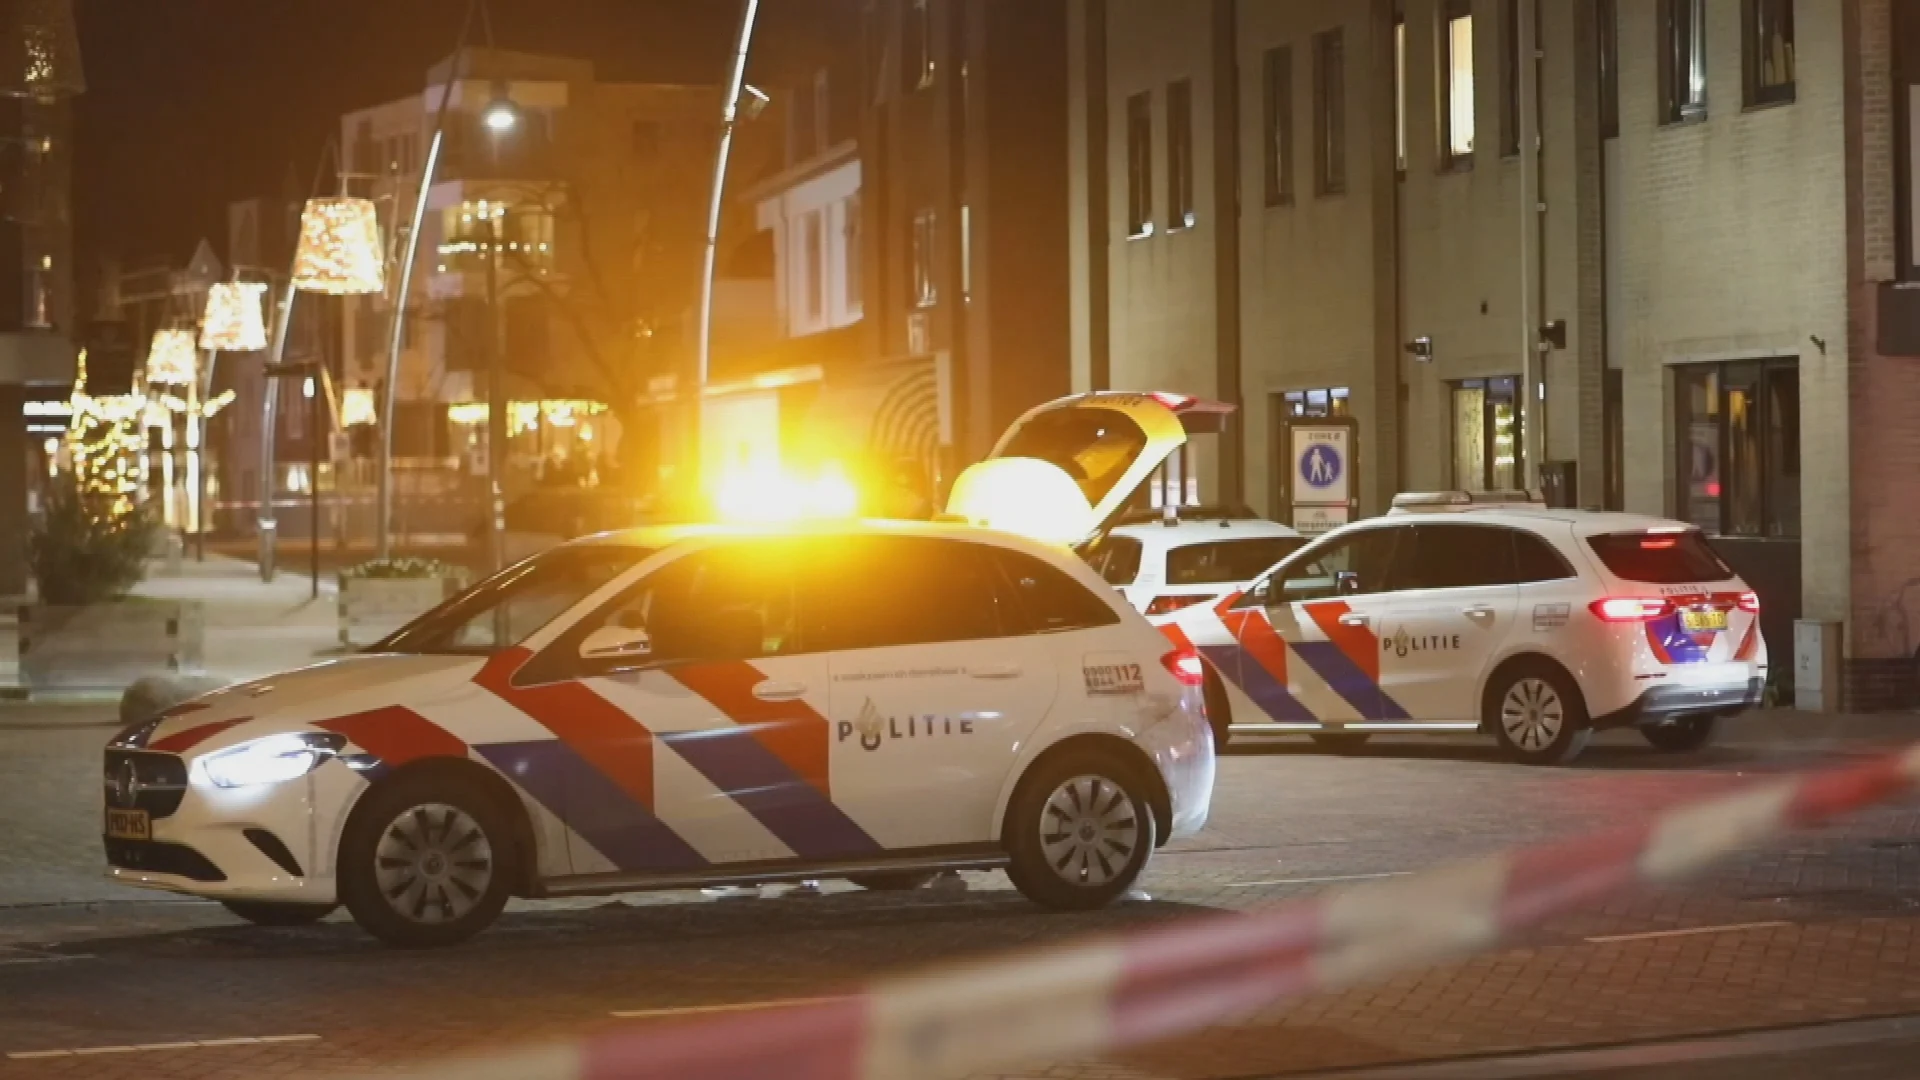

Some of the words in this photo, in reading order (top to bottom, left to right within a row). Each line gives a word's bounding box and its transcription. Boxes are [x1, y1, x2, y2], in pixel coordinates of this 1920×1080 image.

[1383, 633, 1461, 658] POLITIE
[1113, 663, 1143, 681] 112
[837, 712, 975, 752] POLITIE
